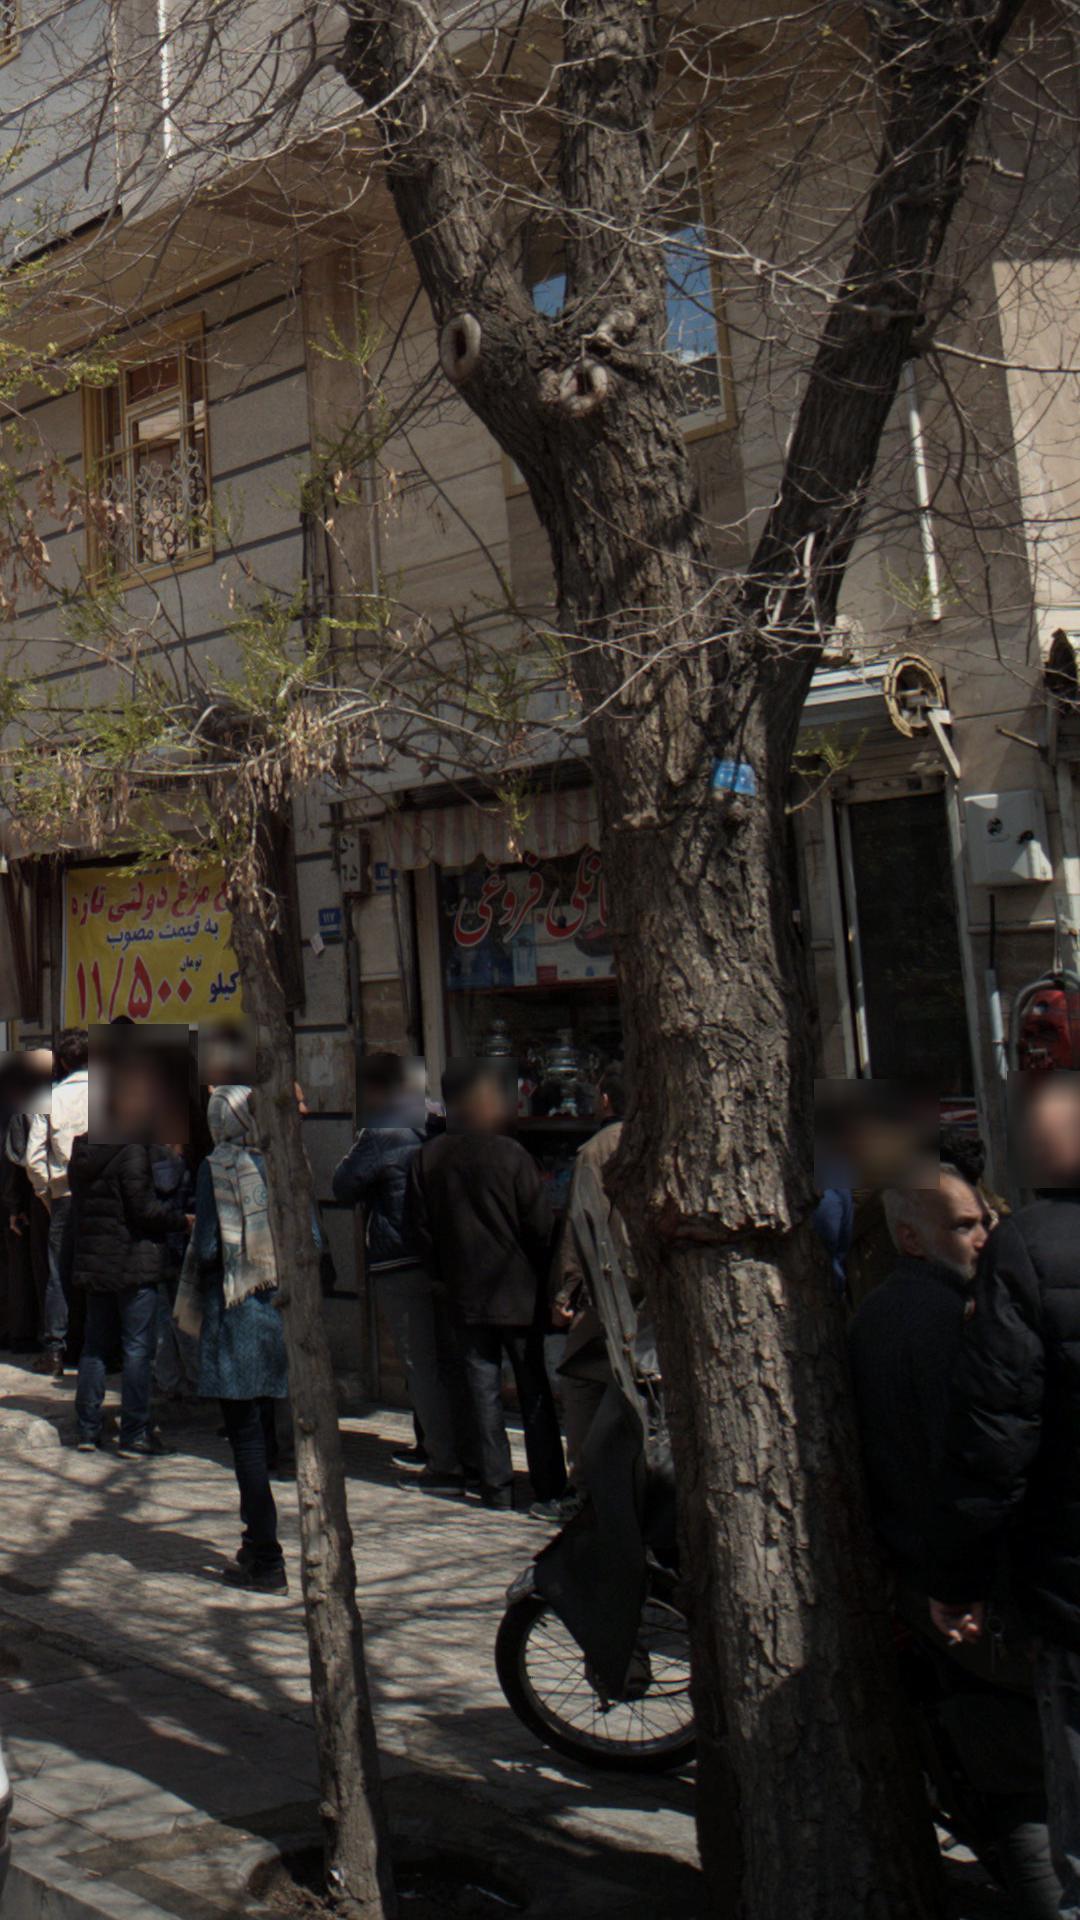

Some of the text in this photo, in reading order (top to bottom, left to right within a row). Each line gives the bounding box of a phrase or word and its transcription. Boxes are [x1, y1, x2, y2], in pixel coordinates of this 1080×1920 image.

[72, 886, 106, 925] تازه
[108, 881, 168, 922] دولتی
[171, 880, 209, 917] مرغ
[107, 915, 218, 951] به قیمت مصوب
[180, 955, 202, 972] تومان
[77, 956, 241, 1020] کیلو ۱۱/۵۰۰
